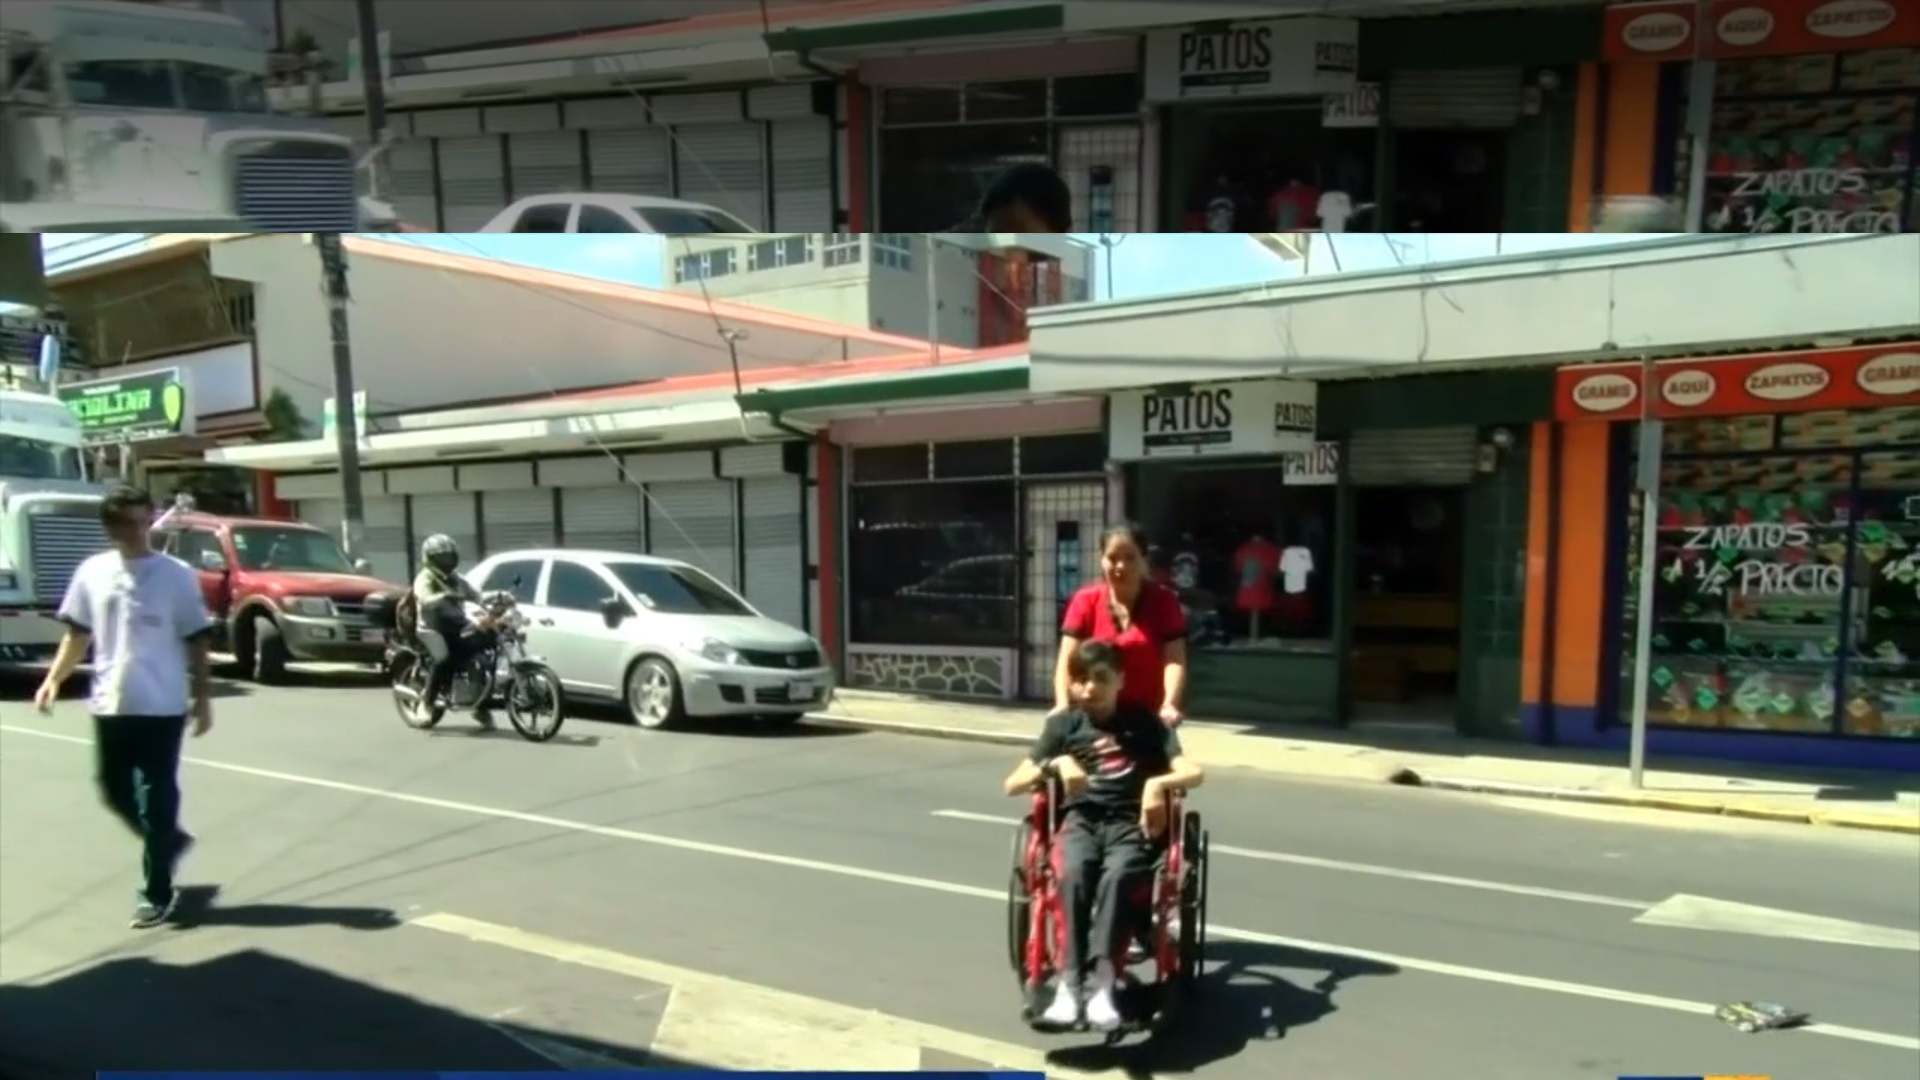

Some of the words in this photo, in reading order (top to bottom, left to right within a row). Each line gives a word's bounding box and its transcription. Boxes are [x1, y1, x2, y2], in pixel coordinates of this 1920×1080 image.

[1179, 27, 1272, 72] PATOS
[1316, 41, 1355, 65] PATOS
[1323, 85, 1380, 117] PATOS
[1732, 168, 1866, 196] ZAPATOS
[1751, 372, 1826, 390] ZAPATOS
[1143, 388, 1232, 431] PATOS
[1275, 403, 1314, 425] PATOS
[1284, 444, 1338, 475] PATOS
[1682, 522, 1810, 549] ZAPATOS
